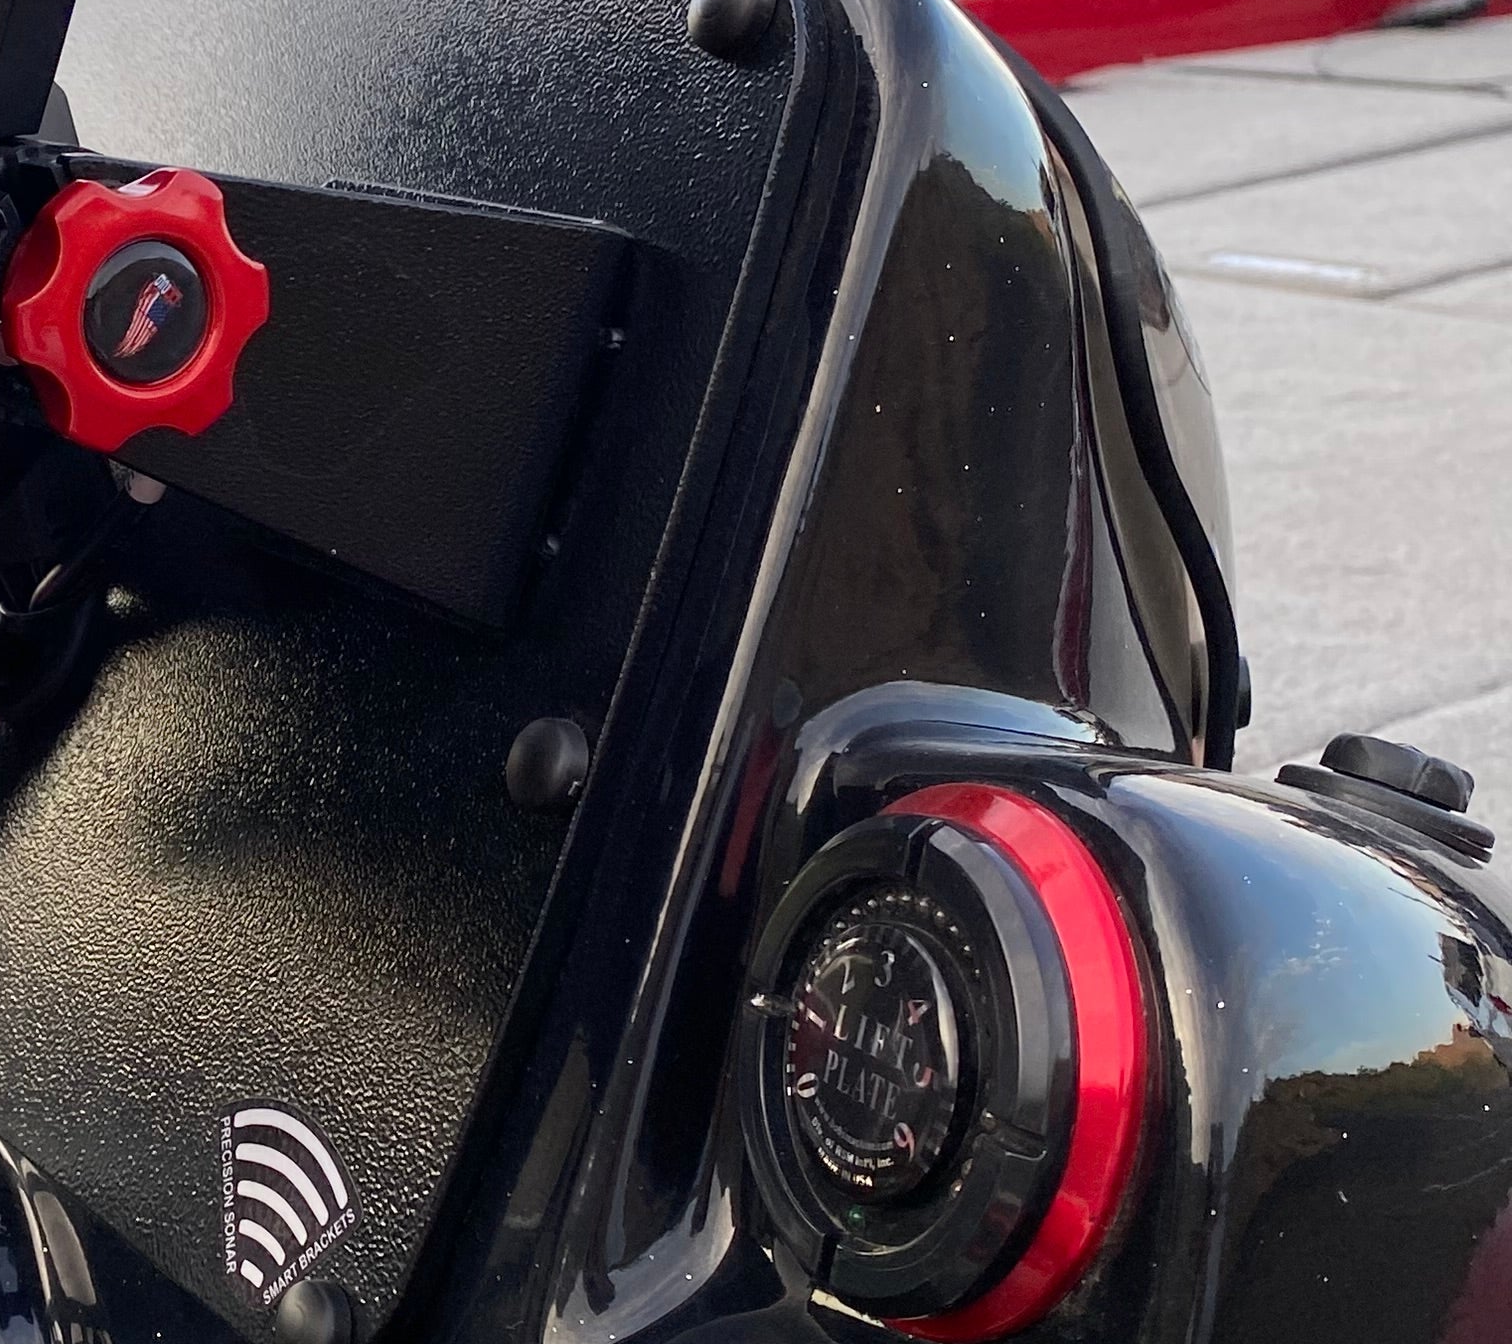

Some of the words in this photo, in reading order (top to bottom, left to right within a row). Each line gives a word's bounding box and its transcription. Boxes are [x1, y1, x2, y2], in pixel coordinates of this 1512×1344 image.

[874, 950, 896, 988] 3
[833, 1004, 915, 1072] LIFT
[822, 1048, 900, 1121] PLATE
[220, 1115, 236, 1208] PRECISION
[223, 1211, 238, 1275] SONAR
[262, 1263, 299, 1306] SMART
[298, 1207, 357, 1271] BRACKETS
